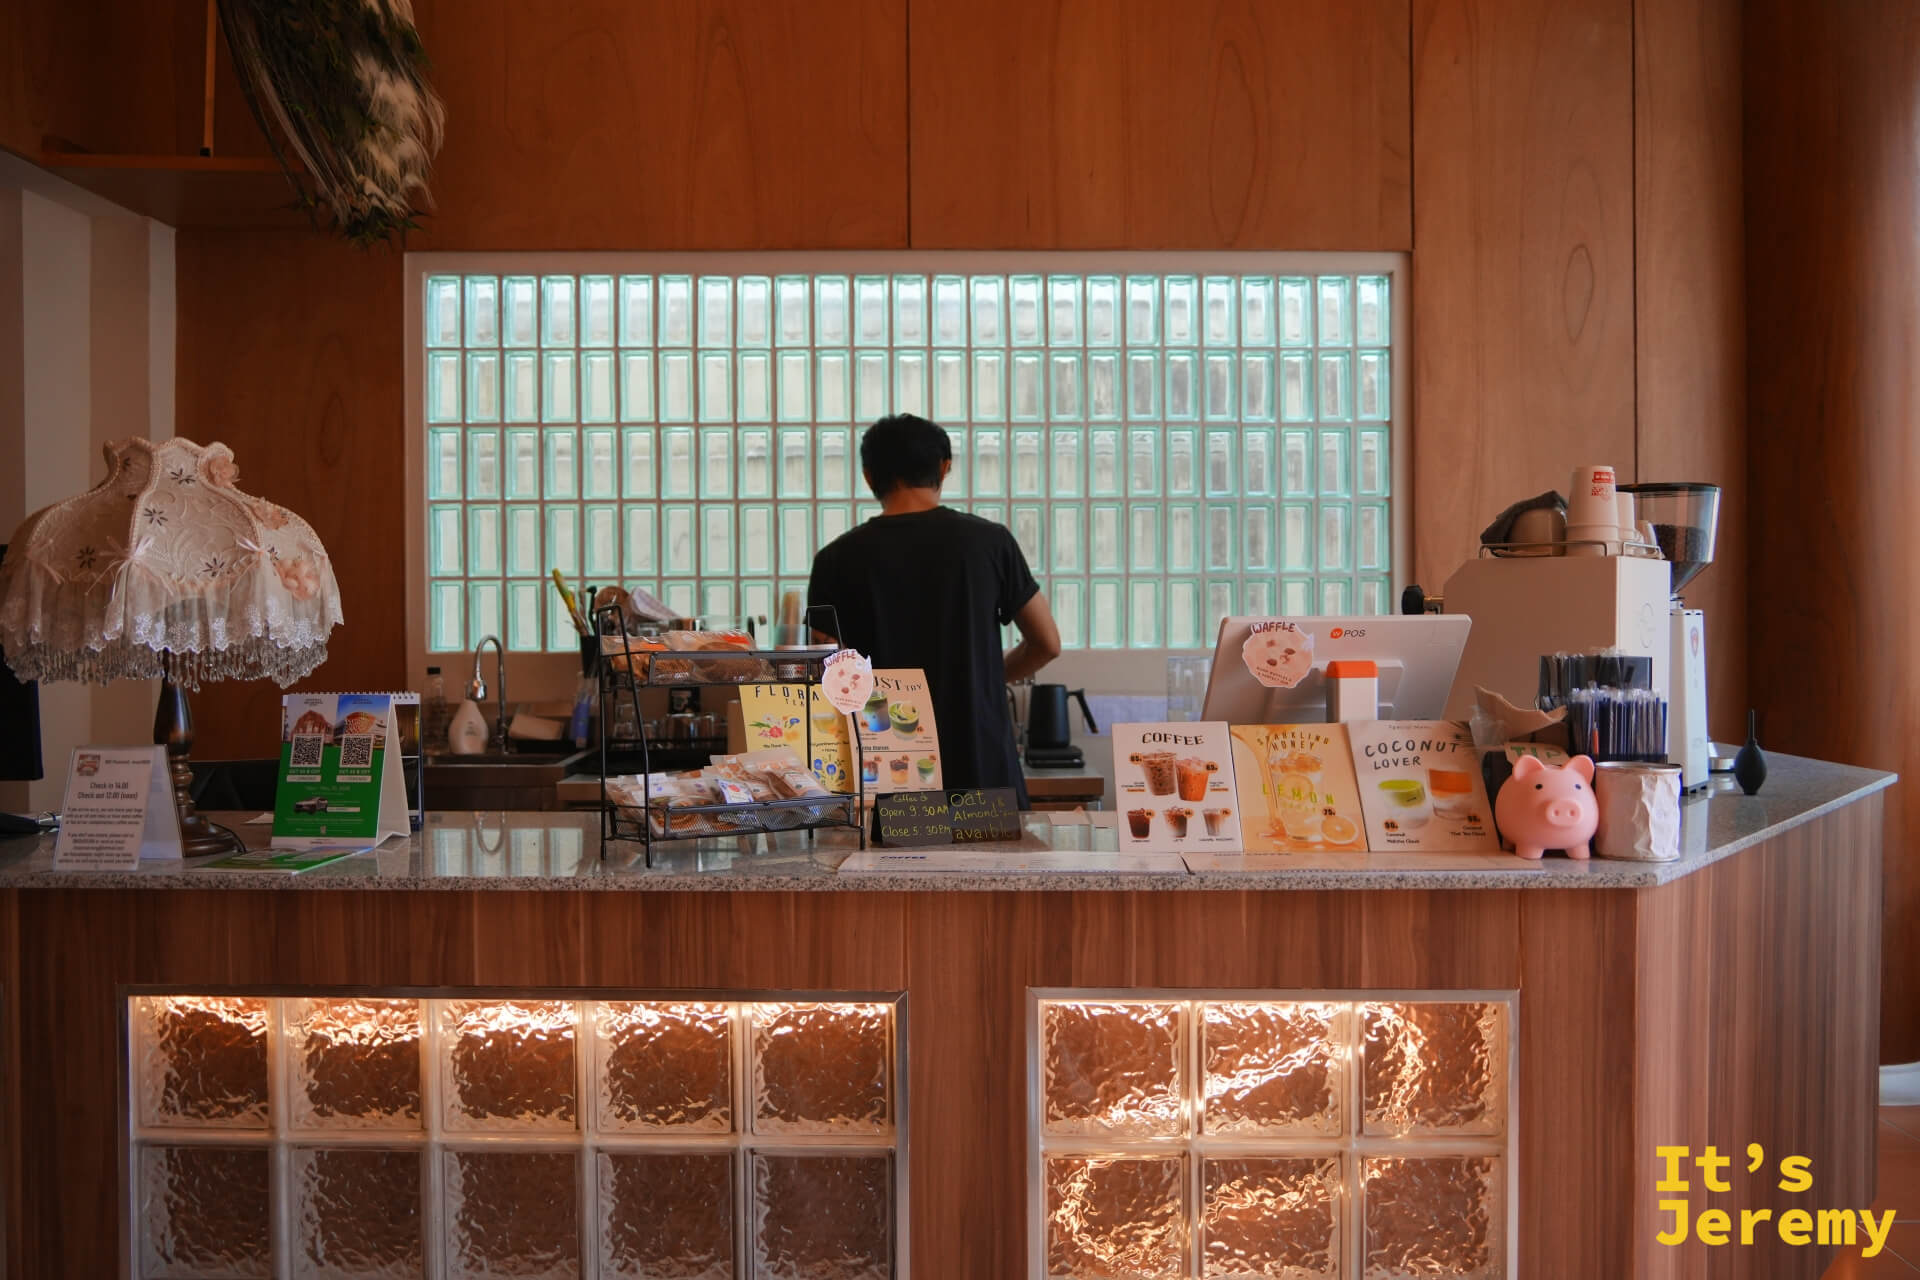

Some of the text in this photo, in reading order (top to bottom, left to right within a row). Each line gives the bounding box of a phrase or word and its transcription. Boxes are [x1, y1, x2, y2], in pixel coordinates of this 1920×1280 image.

[1252, 621, 1296, 634] WAFFLE
[1344, 629, 1366, 638] POS
[824, 650, 857, 667] WAFFLE
[1142, 731, 1205, 746] COFFEE
[1256, 731, 1330, 746] SPARKLING
[1271, 740, 1315, 751] HONEY
[1365, 739, 1459, 757] COCONUT
[1373, 756, 1422, 770] LOVER
[1261, 783, 1335, 805] LEMON
[880, 807, 906, 821] Open
[882, 824, 910, 838] Close
